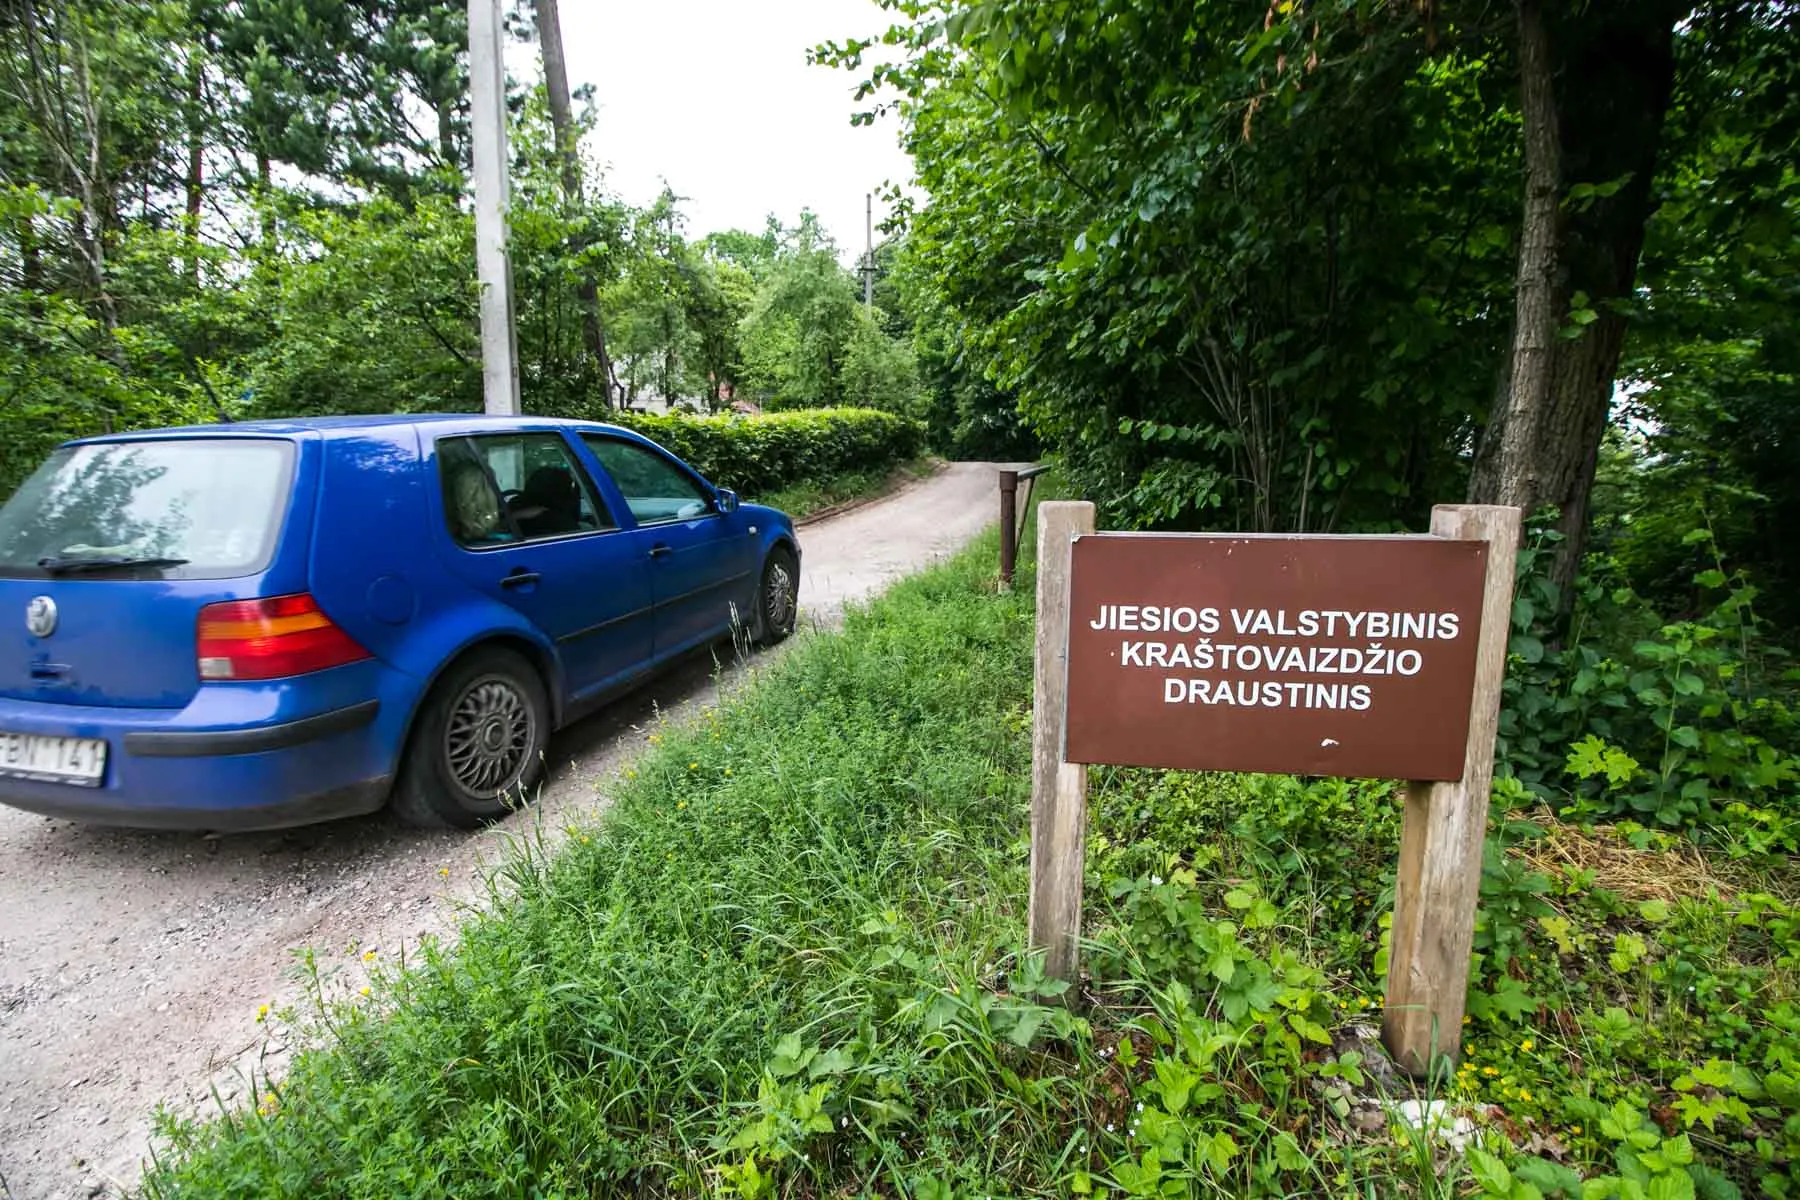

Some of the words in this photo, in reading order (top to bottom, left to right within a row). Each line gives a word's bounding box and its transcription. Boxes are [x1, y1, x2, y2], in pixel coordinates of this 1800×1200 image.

[1089, 604, 1220, 634] JIESIOS
[1230, 607, 1460, 640] VALSTYBINIS
[1120, 637, 1423, 676] KRAŠTOVAIZDŽIO
[1163, 678, 1372, 711] DRAUSTINIS
